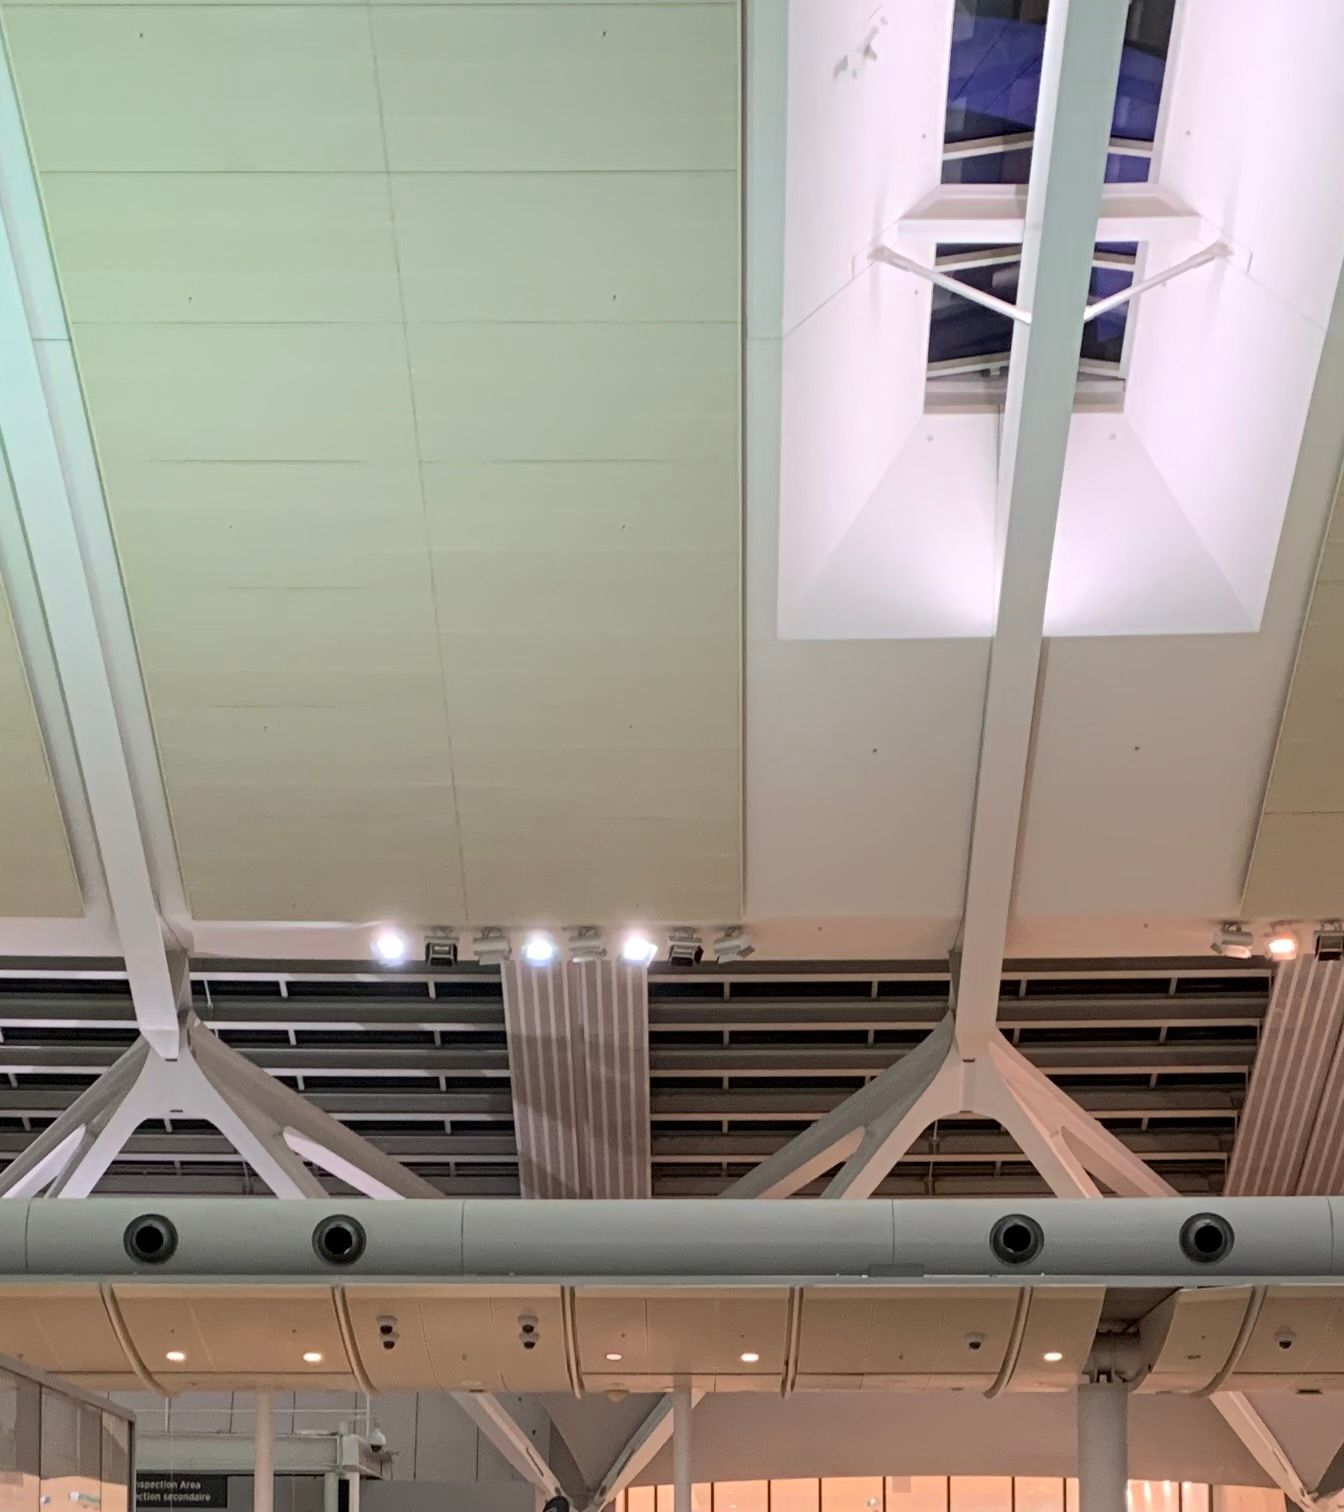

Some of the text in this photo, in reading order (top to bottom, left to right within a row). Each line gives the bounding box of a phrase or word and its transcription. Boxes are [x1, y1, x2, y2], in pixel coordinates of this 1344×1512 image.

[136, 1480, 201, 1491] nspection Area
[163, 1492, 211, 1502] secondaire
